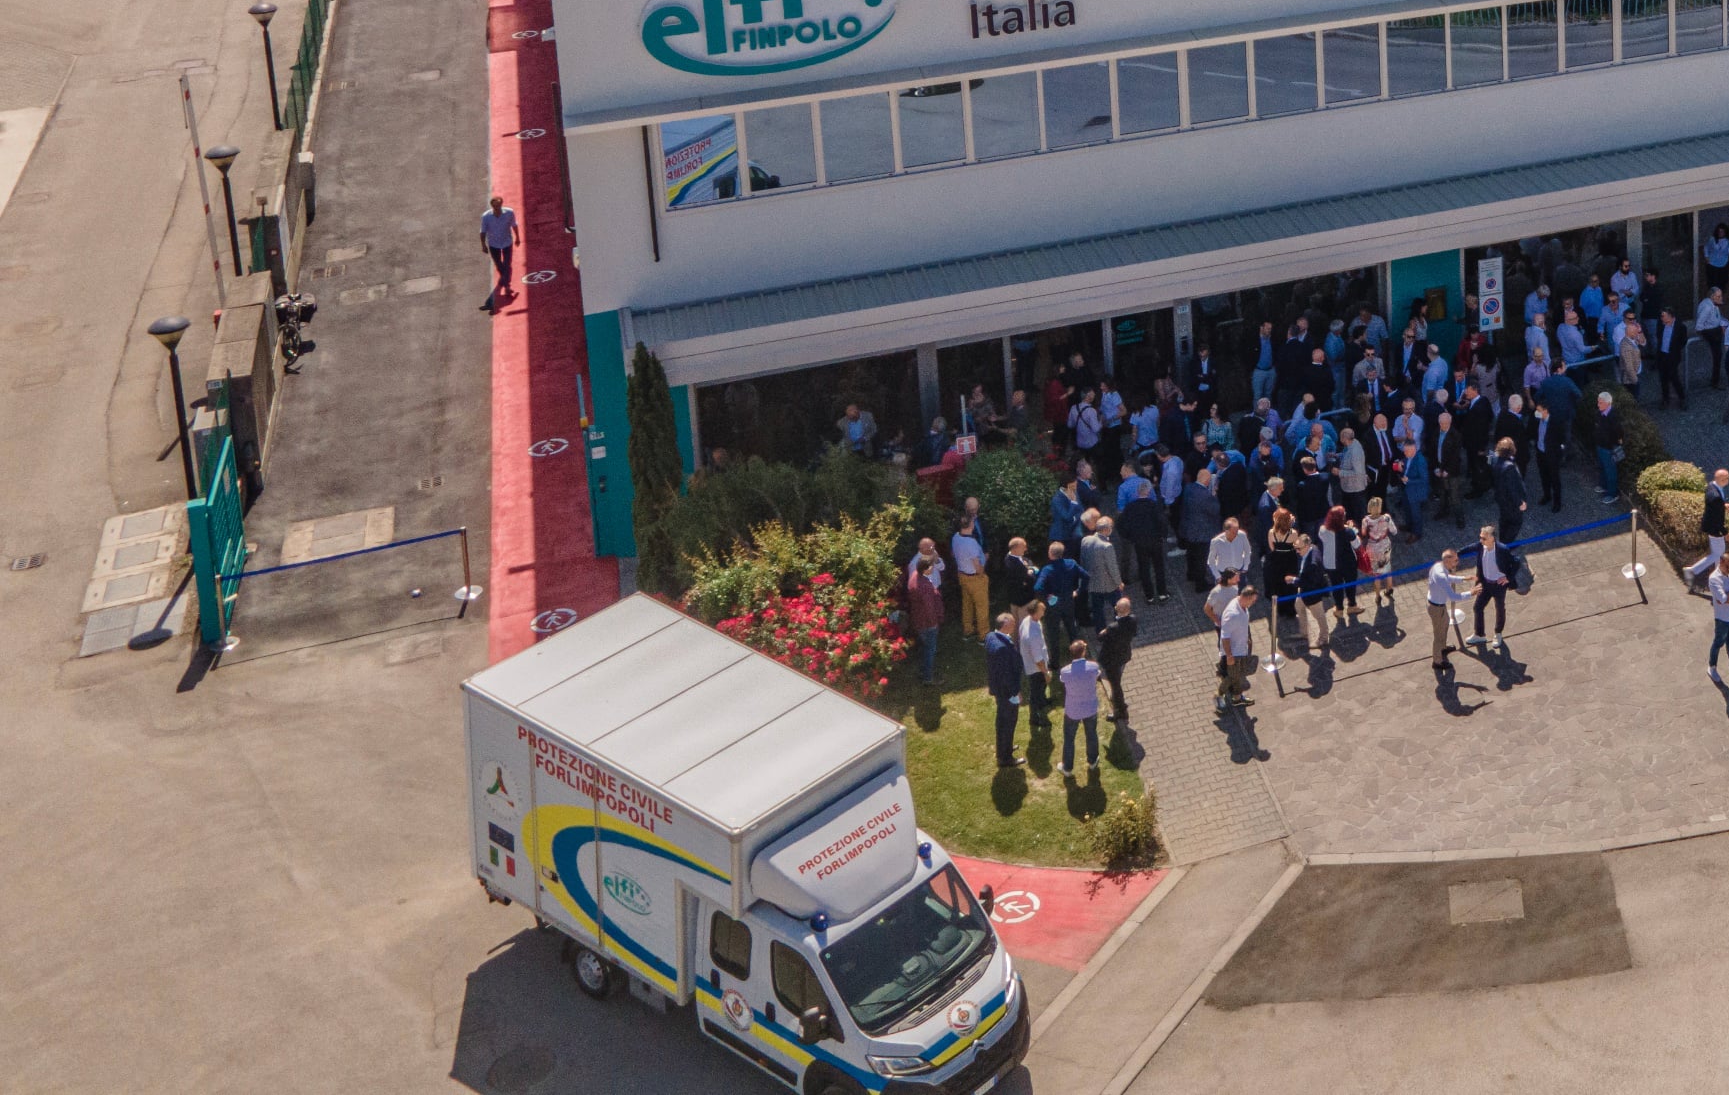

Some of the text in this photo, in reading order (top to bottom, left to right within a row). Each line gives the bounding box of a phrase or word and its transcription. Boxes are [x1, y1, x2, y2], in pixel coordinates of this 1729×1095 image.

[732, 16, 862, 53] FINPOLO
[517, 725, 617, 793] PROTEZIONE
[620, 783, 673, 825] CIVILE
[535, 753, 655, 834] FORLIMPOPOLI
[798, 803, 903, 875] PROTEZIONE CIVILE
[816, 823, 897, 881] FORLIMPOPOLI
